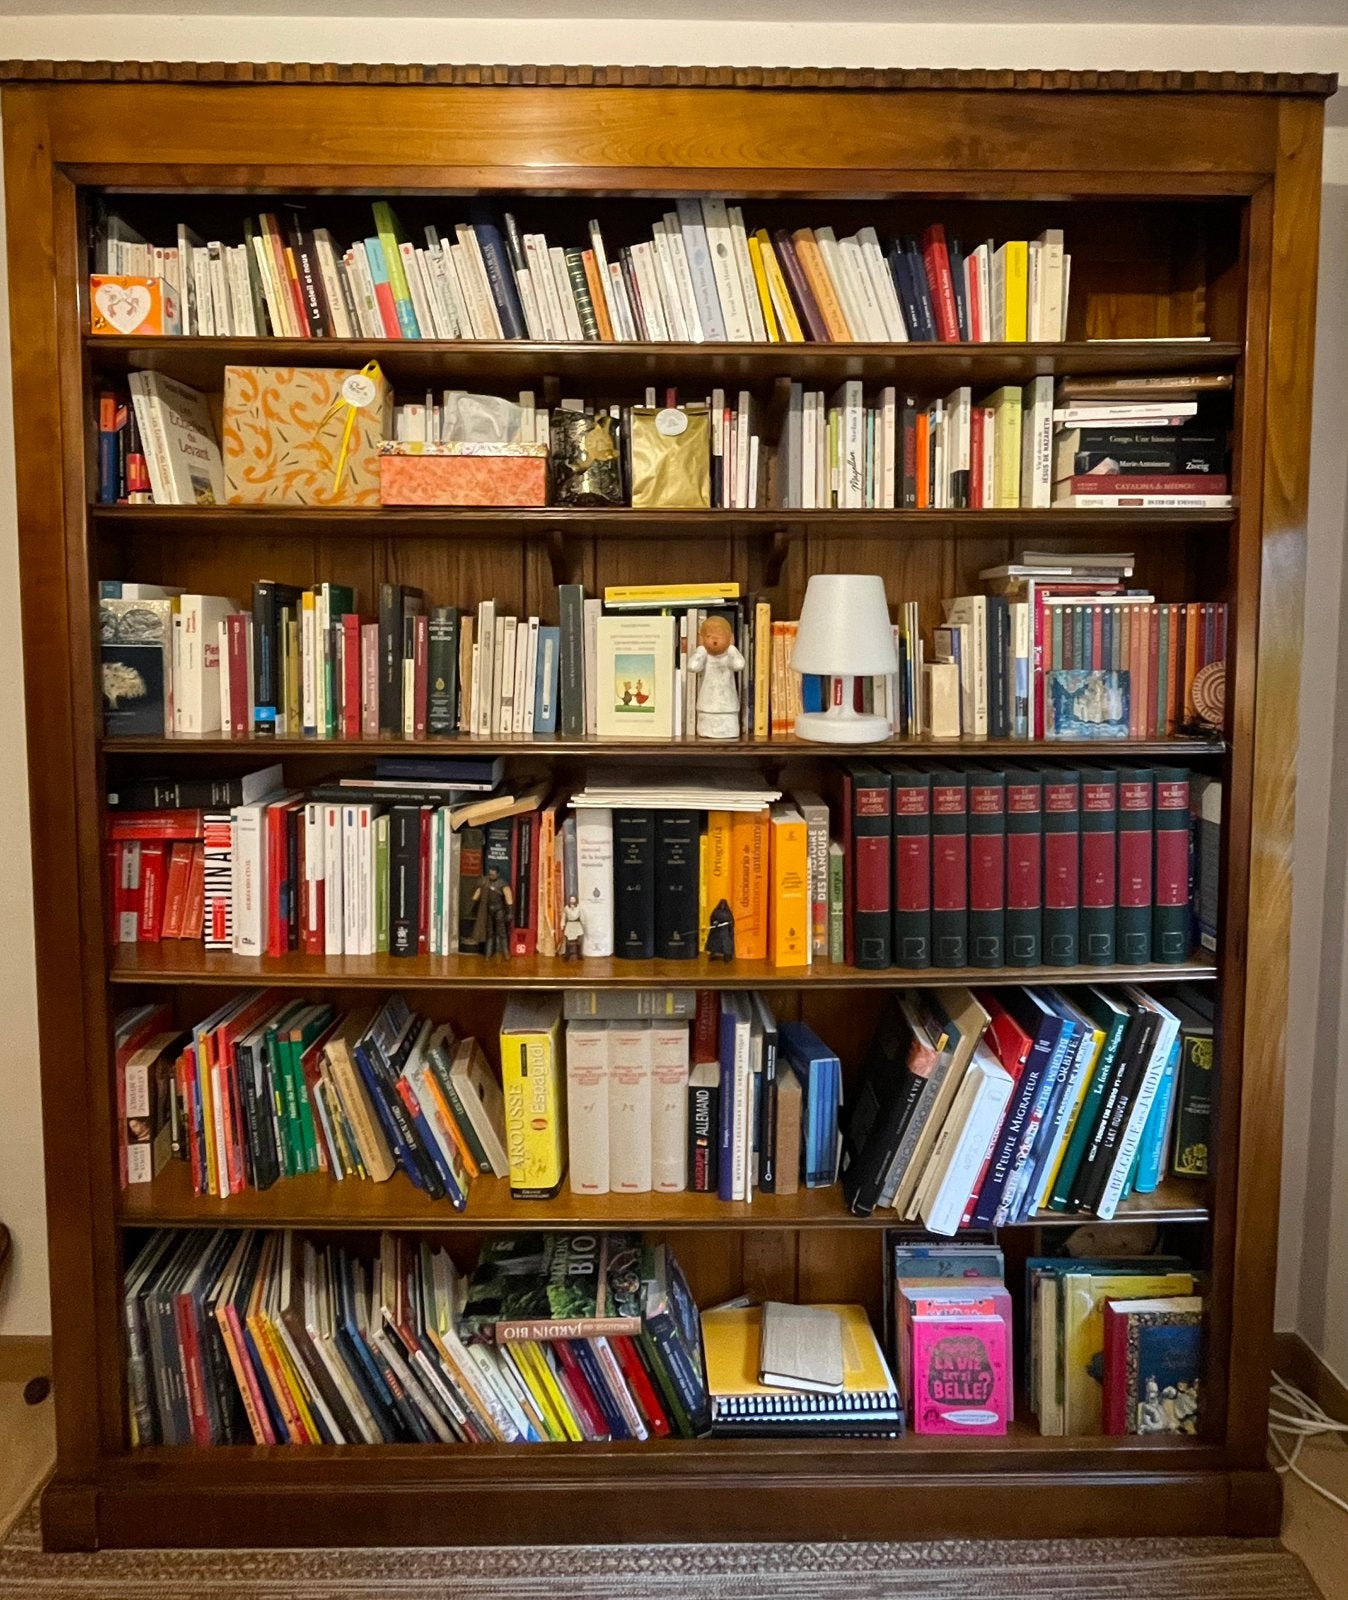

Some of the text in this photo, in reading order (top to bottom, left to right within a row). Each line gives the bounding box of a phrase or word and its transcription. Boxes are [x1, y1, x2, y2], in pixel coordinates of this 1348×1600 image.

[299, 253, 310, 273] nous
[306, 284, 317, 307] Soleil
[178, 438, 211, 461] Levant
[1042, 417, 1050, 451] NAZARETH
[846, 451, 863, 491] Magellan
[906, 494, 914, 502] 10
[713, 826, 723, 876] Ortografía
[818, 829, 826, 899] DES LANGUES
[739, 844, 750, 907] diccionario de
[1047, 1038, 1069, 1083] BELGIUM
[1055, 1038, 1077, 1082] ORBITE
[1072, 1061, 1081, 1072] LA
[1093, 1022, 1125, 1094] La forêt de Soignes
[284, 1074, 293, 1091] Nord
[530, 1043, 548, 1114] Espagnol
[907, 1077, 922, 1103] LA VIE
[1068, 1073, 1076, 1084] DE
[696, 1090, 710, 1136] ALLEMAND
[1057, 1083, 1073, 1114] PASSION
[1102, 1108, 1111, 1119] DES
[510, 1084, 526, 1182] LAROUSSE
[995, 1133, 1017, 1171] PEUPLE
[1008, 1068, 1040, 1132] MIGRATEUR
[1054, 1114, 1062, 1125] LA
[1103, 1095, 1128, 1147] L'ART NOUVEAU
[1108, 1124, 1142, 1191] BELGIQUE
[1137, 1054, 1166, 1108] JARDINS
[569, 1235, 595, 1273] BIO
[503, 1326, 529, 1340] BIO
[533, 1322, 582, 1338] JARDIN
[934, 1356, 981, 1369] LA VIE
